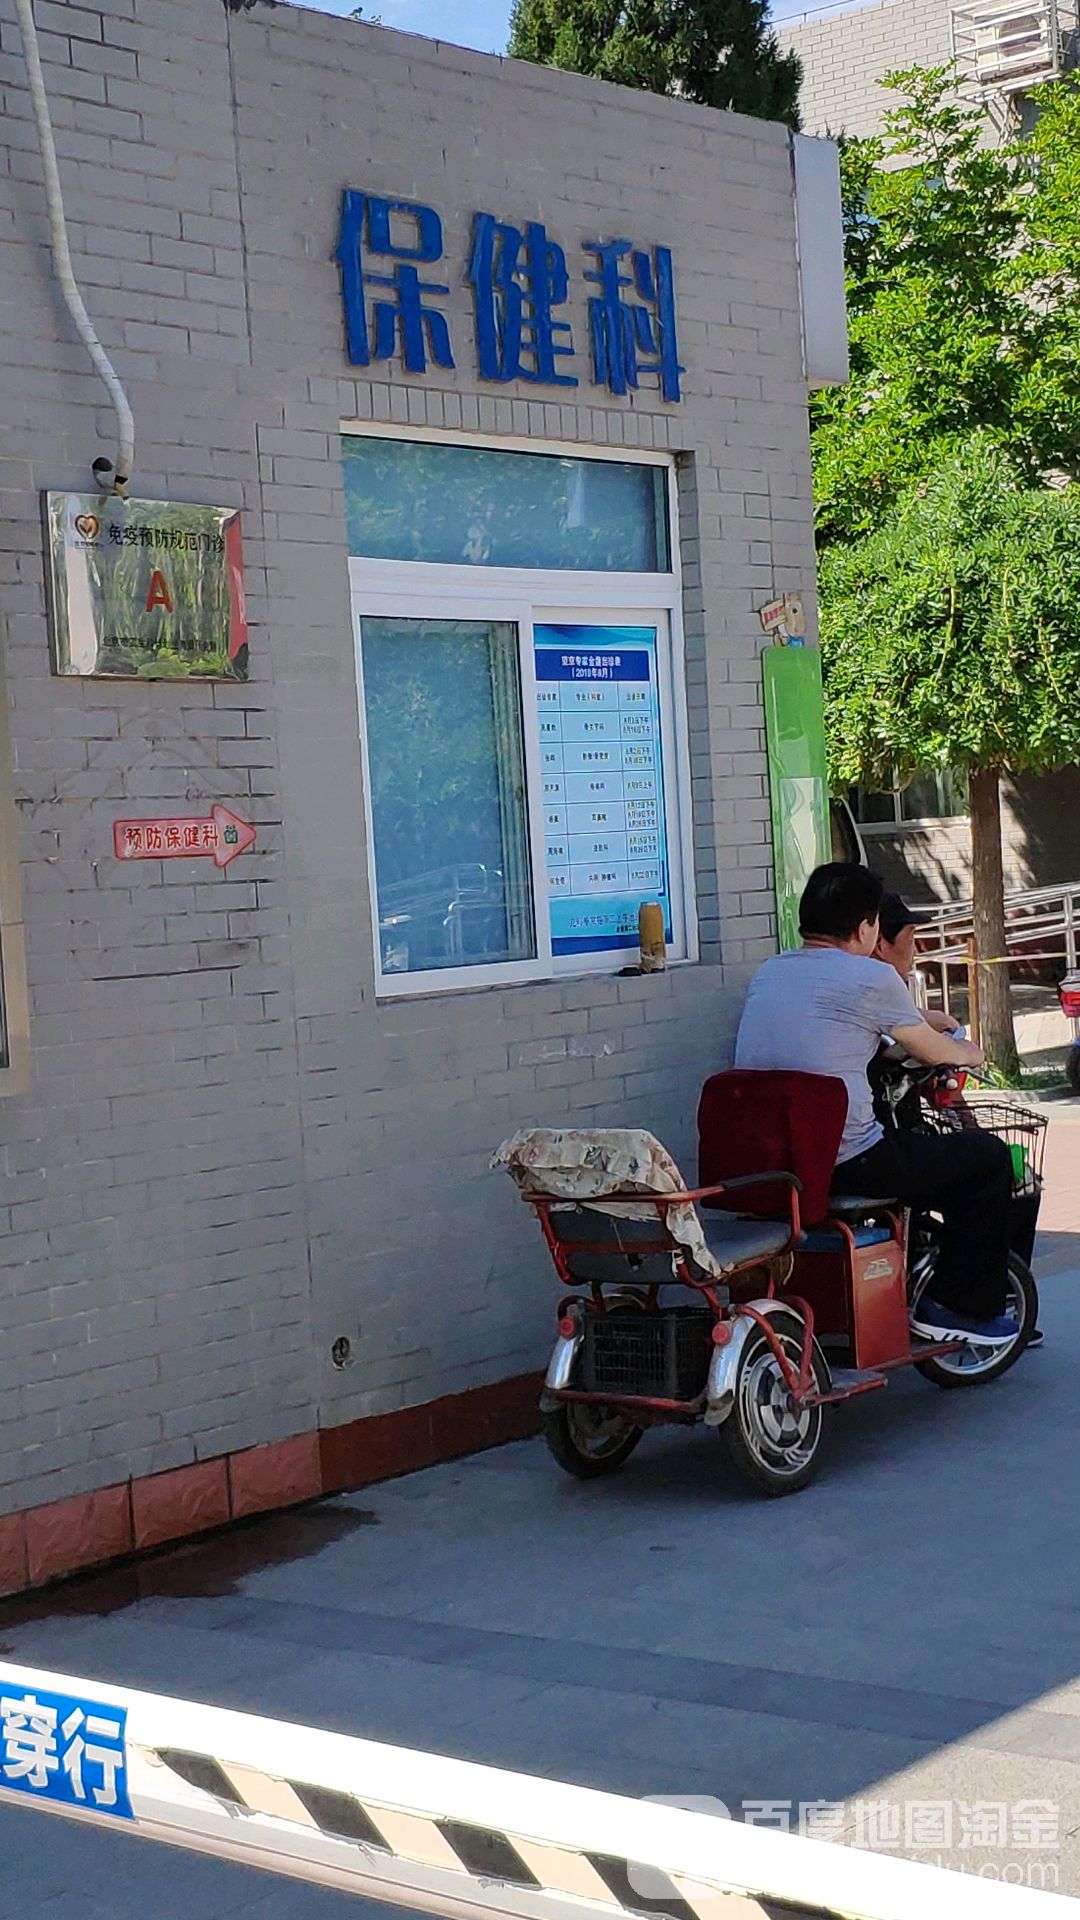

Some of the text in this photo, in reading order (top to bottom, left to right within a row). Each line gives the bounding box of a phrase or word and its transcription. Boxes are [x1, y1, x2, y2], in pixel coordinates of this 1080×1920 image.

[336, 187, 686, 403] 保健科
[108, 523, 225, 554] 免疫预防规范门诊
[145, 570, 174, 614] A
[125, 824, 219, 850] 预防保健科
[1, 1695, 123, 1806] 穿行
